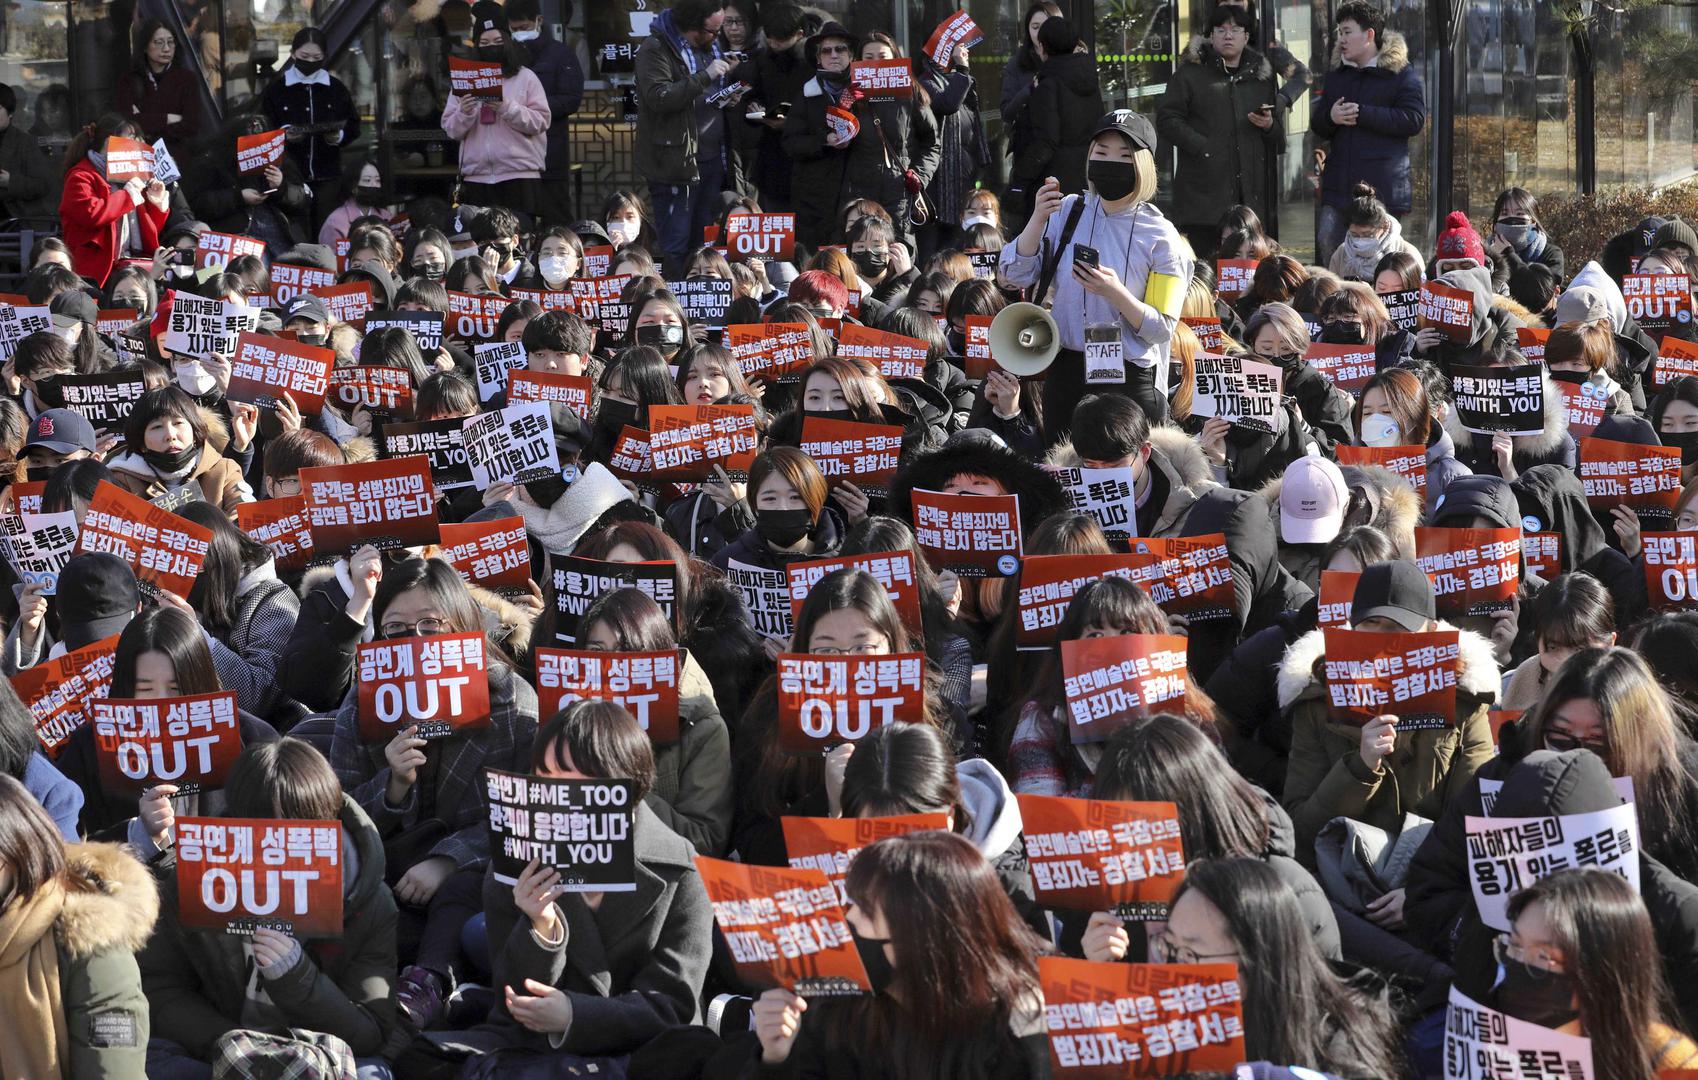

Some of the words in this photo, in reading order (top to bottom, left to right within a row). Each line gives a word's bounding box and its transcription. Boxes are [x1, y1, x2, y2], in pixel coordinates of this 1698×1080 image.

[729, 216, 759, 233] 공연계
[762, 216, 794, 233] 성폭력
[198, 232, 232, 252] 공연계
[736, 234, 785, 254] OUT
[271, 265, 299, 284] 공연계
[1624, 277, 1652, 296] 공연계
[1654, 276, 1690, 296] 성폭력
[173, 297, 224, 316] 피해자들의
[449, 294, 480, 316] 공연계
[686, 308, 724, 318] ITH_YOU
[689, 294, 731, 308] 응원합니다
[1629, 296, 1681, 319] OUT
[21, 316, 49, 334] 폭로를
[172, 314, 198, 333] 용기
[202, 318, 223, 334] 있는
[226, 315, 254, 332] 폭로를
[242, 343, 274, 364] 관객은
[278, 352, 326, 376] 성범죄자의
[892, 346, 928, 360] 극장으로
[1087, 344, 1122, 358] STAFF
[1194, 358, 1242, 374] 피해자들의
[232, 361, 263, 382] 공연을
[264, 366, 290, 388] 원치
[292, 372, 327, 396] 않는다
[880, 361, 923, 378] 경찰서로
[1196, 374, 1222, 394] 용기
[1225, 377, 1245, 393] 있는
[1246, 374, 1278, 393] 폭로를
[62, 382, 144, 402] #용기있는폭로
[339, 385, 400, 410] OUT
[512, 380, 540, 396] 관객은
[541, 384, 586, 403] 성범죄자의
[1453, 375, 1542, 395] #용기있는폭로
[67, 402, 136, 422] #WITH_YO
[1214, 394, 1274, 416] 지지합니다
[1456, 396, 1540, 417] #WITH_YOU
[386, 428, 463, 452] #용기있는폭
[462, 409, 504, 444] 피해자들의
[467, 438, 493, 468] 용기
[486, 432, 511, 454] 있는
[510, 413, 550, 441] 폭로를
[650, 424, 712, 448] 공연예술인은
[713, 415, 755, 436] 극장으로
[484, 441, 549, 484] 지지합니다
[653, 446, 702, 470] 범죄자는
[702, 435, 757, 460] 경찰서로
[800, 439, 863, 461] 공연예술인은
[865, 434, 903, 451] 극장으로
[854, 452, 898, 472] 경찰서로
[1580, 461, 1638, 477] 공연예술인은
[1639, 456, 1682, 472] 극장으로
[311, 482, 356, 505] 관객은
[358, 474, 424, 500] 성범죄자의
[1089, 480, 1130, 502] 폭로를
[1584, 479, 1627, 496] 범죄자는
[1629, 476, 1682, 494] 경찰서로
[310, 506, 348, 527] 공연을
[350, 502, 382, 525] 원치
[384, 492, 434, 520] 않는다
[917, 504, 949, 528] 관객은
[951, 511, 1010, 530] 성범죄자의
[11, 537, 35, 560] 있는
[32, 524, 78, 551] 폭로를
[84, 509, 158, 544] 공연예술인은
[160, 527, 210, 556] 극장으로
[478, 527, 528, 550] 극장으로
[916, 527, 942, 549] 공연을
[943, 526, 970, 551] 원치
[973, 530, 1017, 551] 않는다
[1480, 534, 1520, 554] 극장으로
[139, 548, 198, 578] 경찰서로
[470, 550, 529, 580] 경찰서로
[1181, 544, 1229, 569] 극장으로
[1643, 536, 1696, 566] 공연계
[728, 567, 787, 590] 피해자들의
[1174, 566, 1232, 599] 경찰서로
[1468, 562, 1519, 590] 경찰서로
[360, 642, 414, 682] 공연계
[420, 637, 483, 676] 성폭력
[539, 654, 602, 695] 공연계
[608, 656, 675, 692] 성폭력
[1326, 654, 1404, 680] 공연예술인은
[1406, 642, 1459, 667] 극장으로
[780, 660, 848, 695] 공연계
[854, 658, 921, 696] 성폭력
[1065, 657, 1152, 702] 공연예술인은
[1329, 682, 1389, 708] 범죄자는
[1390, 668, 1456, 703] 경찰서로
[375, 676, 470, 724] OUT
[1071, 687, 1141, 726] 범죄자는
[93, 703, 161, 738] 공연계
[166, 696, 235, 737] 성폭력
[800, 696, 905, 741] OUT
[116, 734, 220, 780] OUT
[490, 801, 530, 839] 관객이
[534, 810, 630, 843] 응원합니다
[178, 823, 254, 865] 공연계
[261, 824, 338, 866] 성폭력
[1025, 830, 1113, 858] 공연예술인은
[1112, 817, 1180, 850] 극장으로
[1466, 816, 1564, 860] 피해자들의
[504, 836, 613, 873] #WITH_YOU
[1031, 859, 1100, 890] 범죄자는
[1100, 847, 1186, 887] 경찰서로
[1473, 857, 1524, 896] 용기
[1574, 828, 1634, 868] 폭로를
[201, 869, 320, 916] OUT
[772, 917, 853, 959] 경찰서로
[1046, 995, 1158, 1031] 공연예술인은
[1159, 980, 1242, 1016] 극장으로
[1052, 1036, 1142, 1068] 범죄자는
[1142, 1012, 1246, 1060] 경찰서로
[1448, 1036, 1472, 1078] 용기
